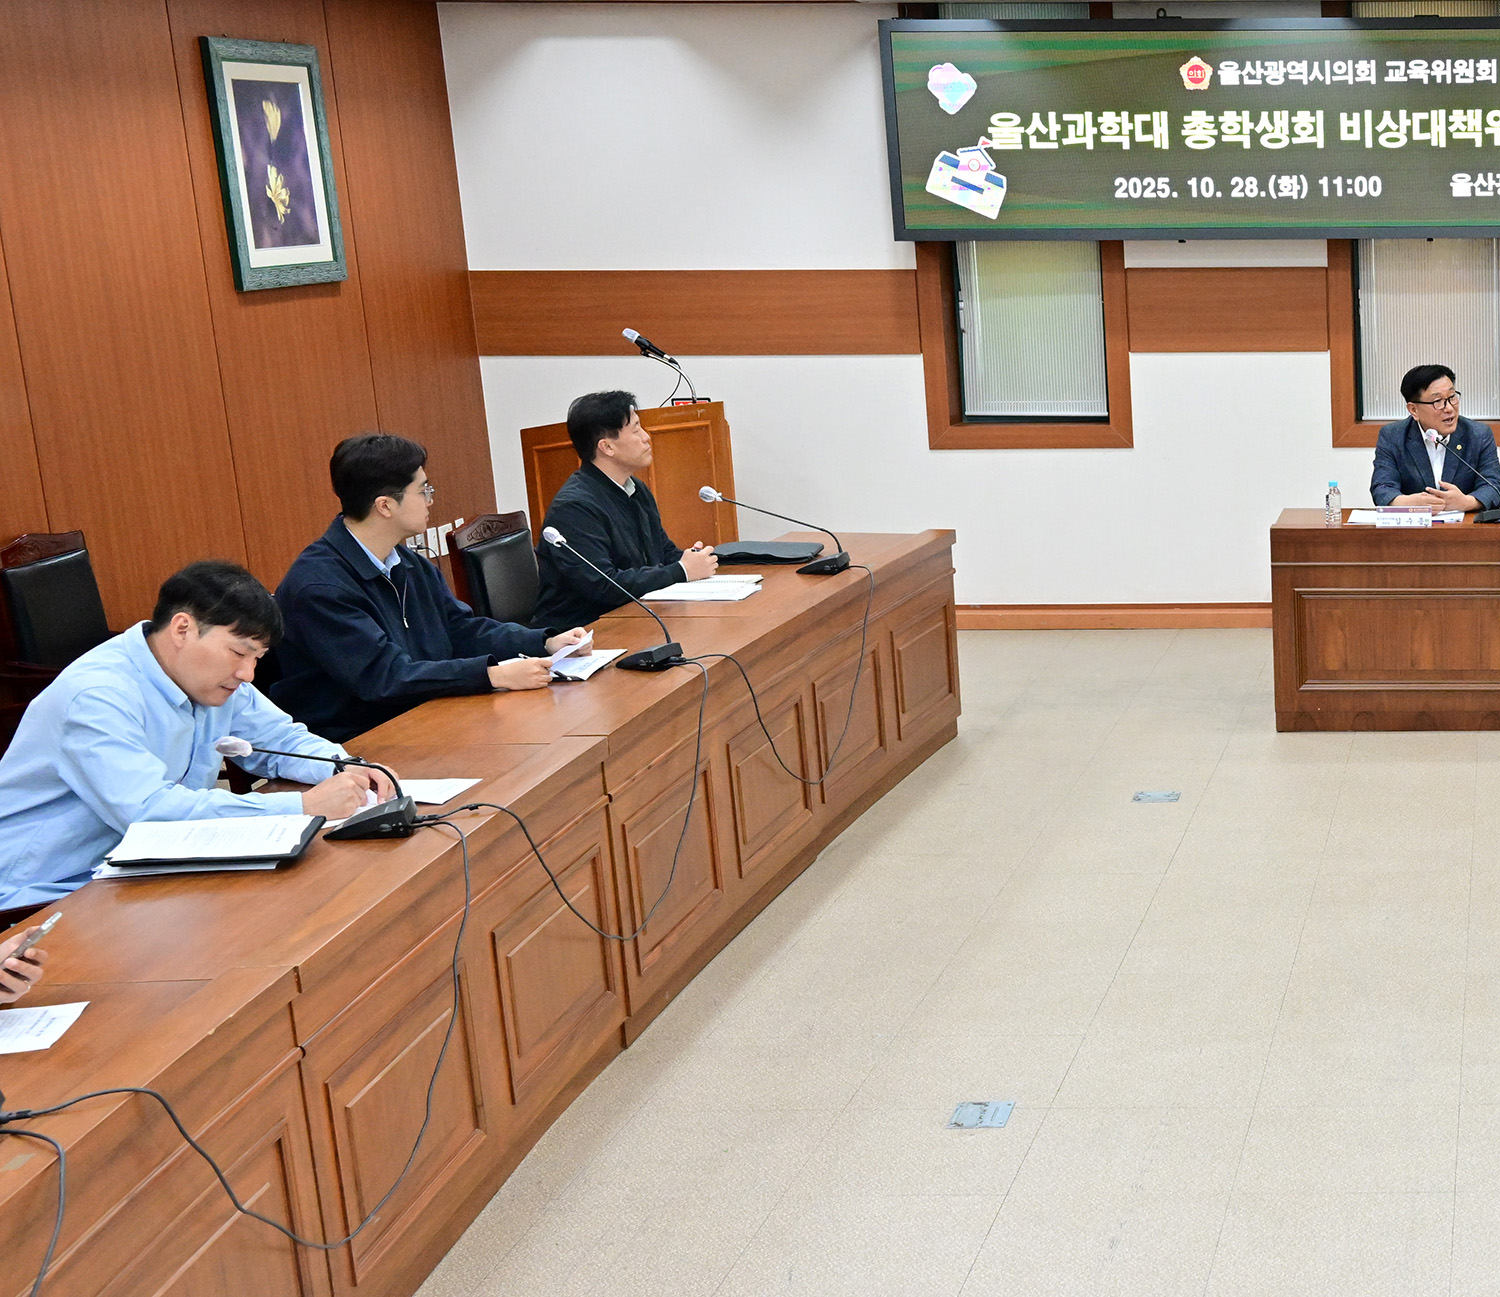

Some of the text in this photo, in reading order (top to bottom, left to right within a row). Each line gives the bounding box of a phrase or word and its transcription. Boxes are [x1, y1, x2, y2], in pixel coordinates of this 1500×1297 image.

[1217, 59, 1377, 86] 울산광역시의회
[1383, 58, 1498, 85] 교육위원회
[987, 110, 1170, 150] 울산과학대
[1181, 109, 1325, 150] 총학생회
[1114, 174, 1383, 200] 2025. 10. 28.(화) 11:00
